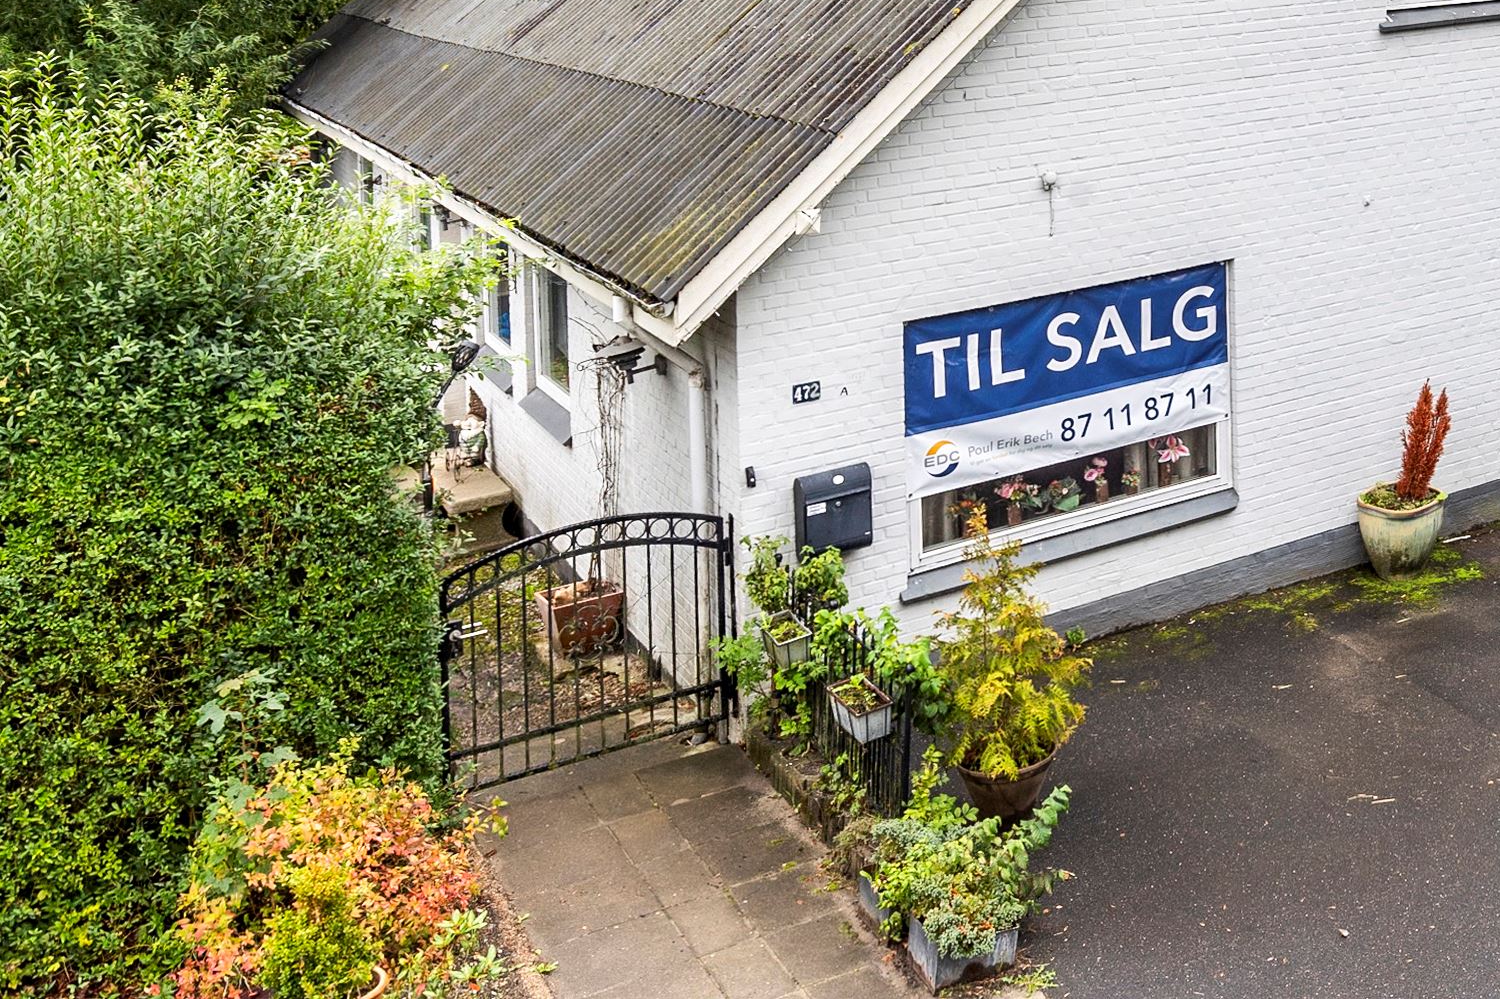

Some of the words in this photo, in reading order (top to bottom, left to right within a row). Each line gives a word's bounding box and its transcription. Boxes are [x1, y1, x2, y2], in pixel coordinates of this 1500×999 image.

[916, 328, 1026, 398] TIL
[1046, 285, 1217, 372] SALG
[794, 383, 820, 401] 472
[1061, 412, 1092, 442] 87
[1103, 403, 1132, 430] 11
[1144, 392, 1174, 420] 87
[1186, 384, 1211, 409] 11
[968, 441, 993, 457] Poul
[997, 437, 1021, 450] Erik
[1024, 429, 1053, 445] Bech
[924, 450, 960, 468] EDC
